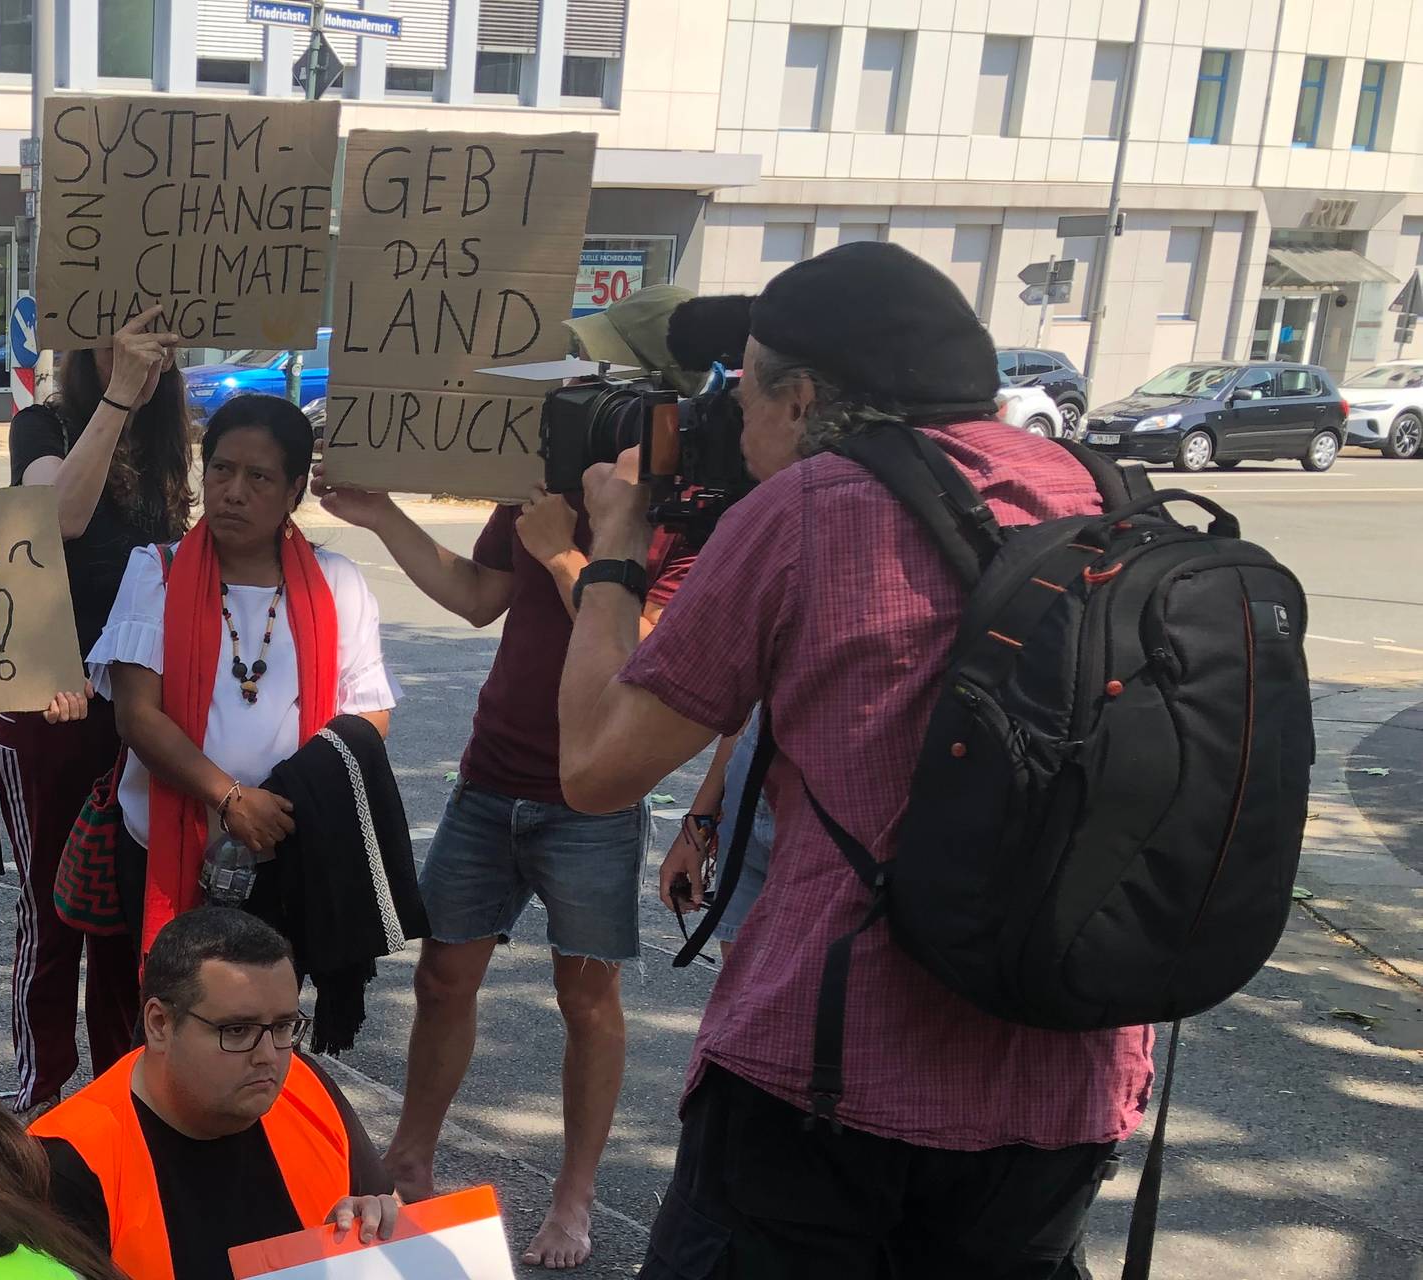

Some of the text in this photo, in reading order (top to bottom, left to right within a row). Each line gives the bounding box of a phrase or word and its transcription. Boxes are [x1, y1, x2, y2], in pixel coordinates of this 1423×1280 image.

[254, 6, 308, 23] Friedrichstr.
[325, 13, 395, 34] Hohenzollernstr.
[141, 182, 333, 238] CHANGE
[361, 144, 565, 228] GEBT
[60, 191, 105, 270] NOT
[136, 242, 322, 299] CLIMATE
[383, 237, 480, 281] DAS
[343, 280, 541, 360] LAND
